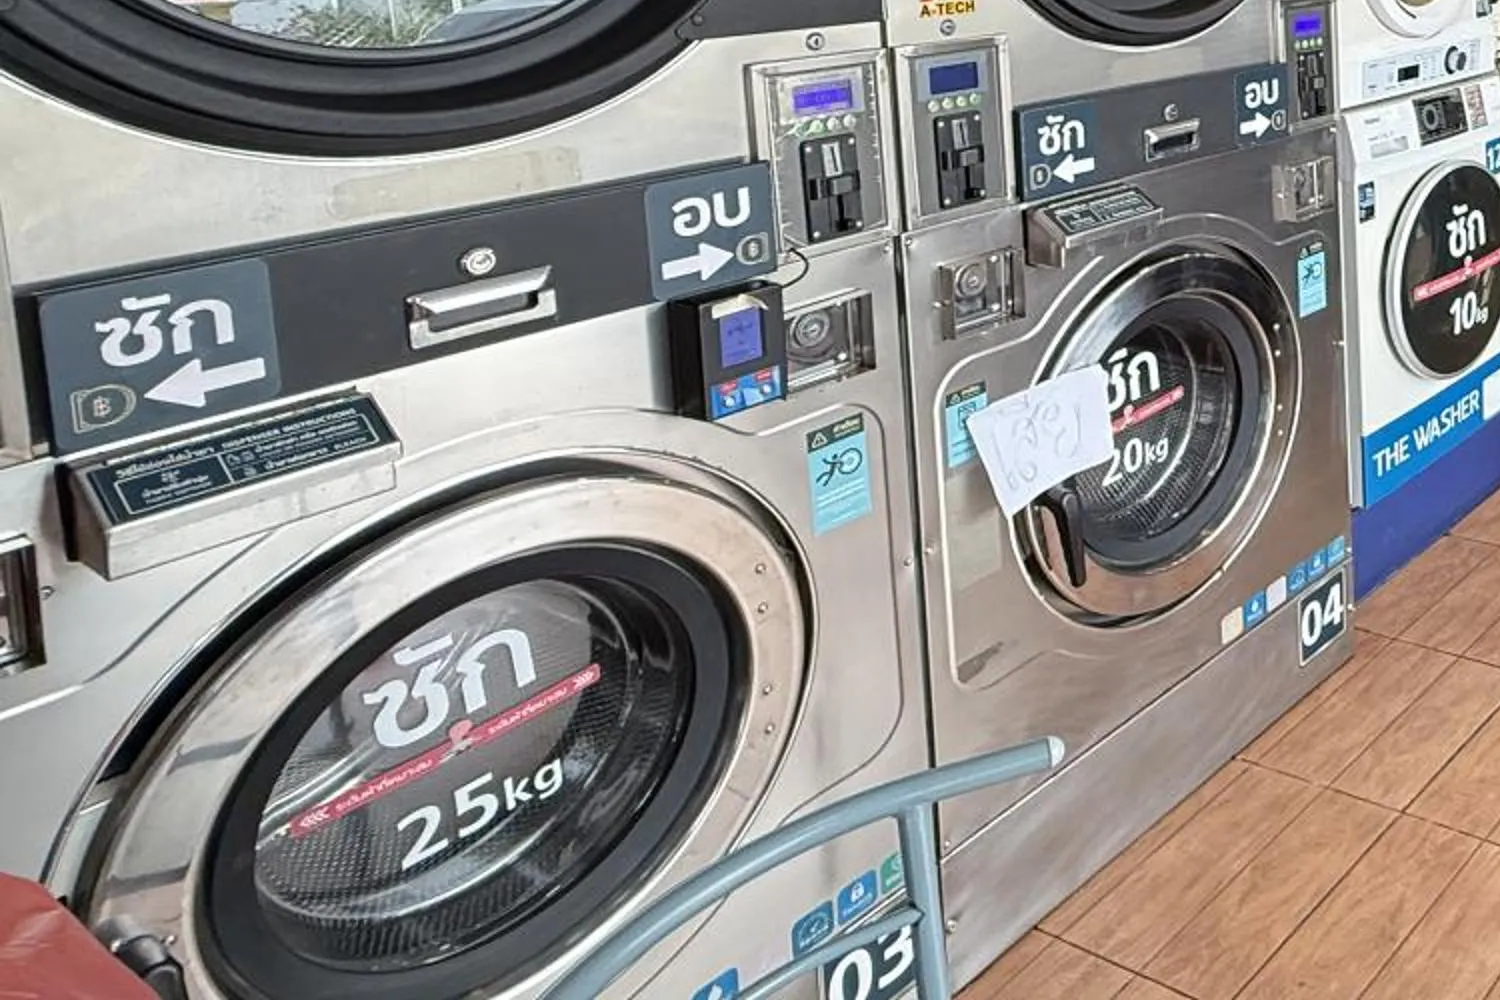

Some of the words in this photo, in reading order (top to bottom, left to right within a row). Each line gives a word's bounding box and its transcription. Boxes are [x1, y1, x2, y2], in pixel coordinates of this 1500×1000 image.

[1244, 77, 1281, 108] อบ
[1038, 114, 1086, 156] ซัก
[672, 186, 750, 237] อบ
[1445, 204, 1486, 259] ซัก
[94, 292, 234, 368] ซัก
[1101, 437, 1169, 487] 20kg
[1373, 441, 1410, 478] THE
[1412, 389, 1480, 455] WASHER
[1301, 582, 1344, 647] 04
[363, 625, 538, 749] ซัก
[397, 756, 565, 871] 25kg
[829, 924, 914, 1000] 03
